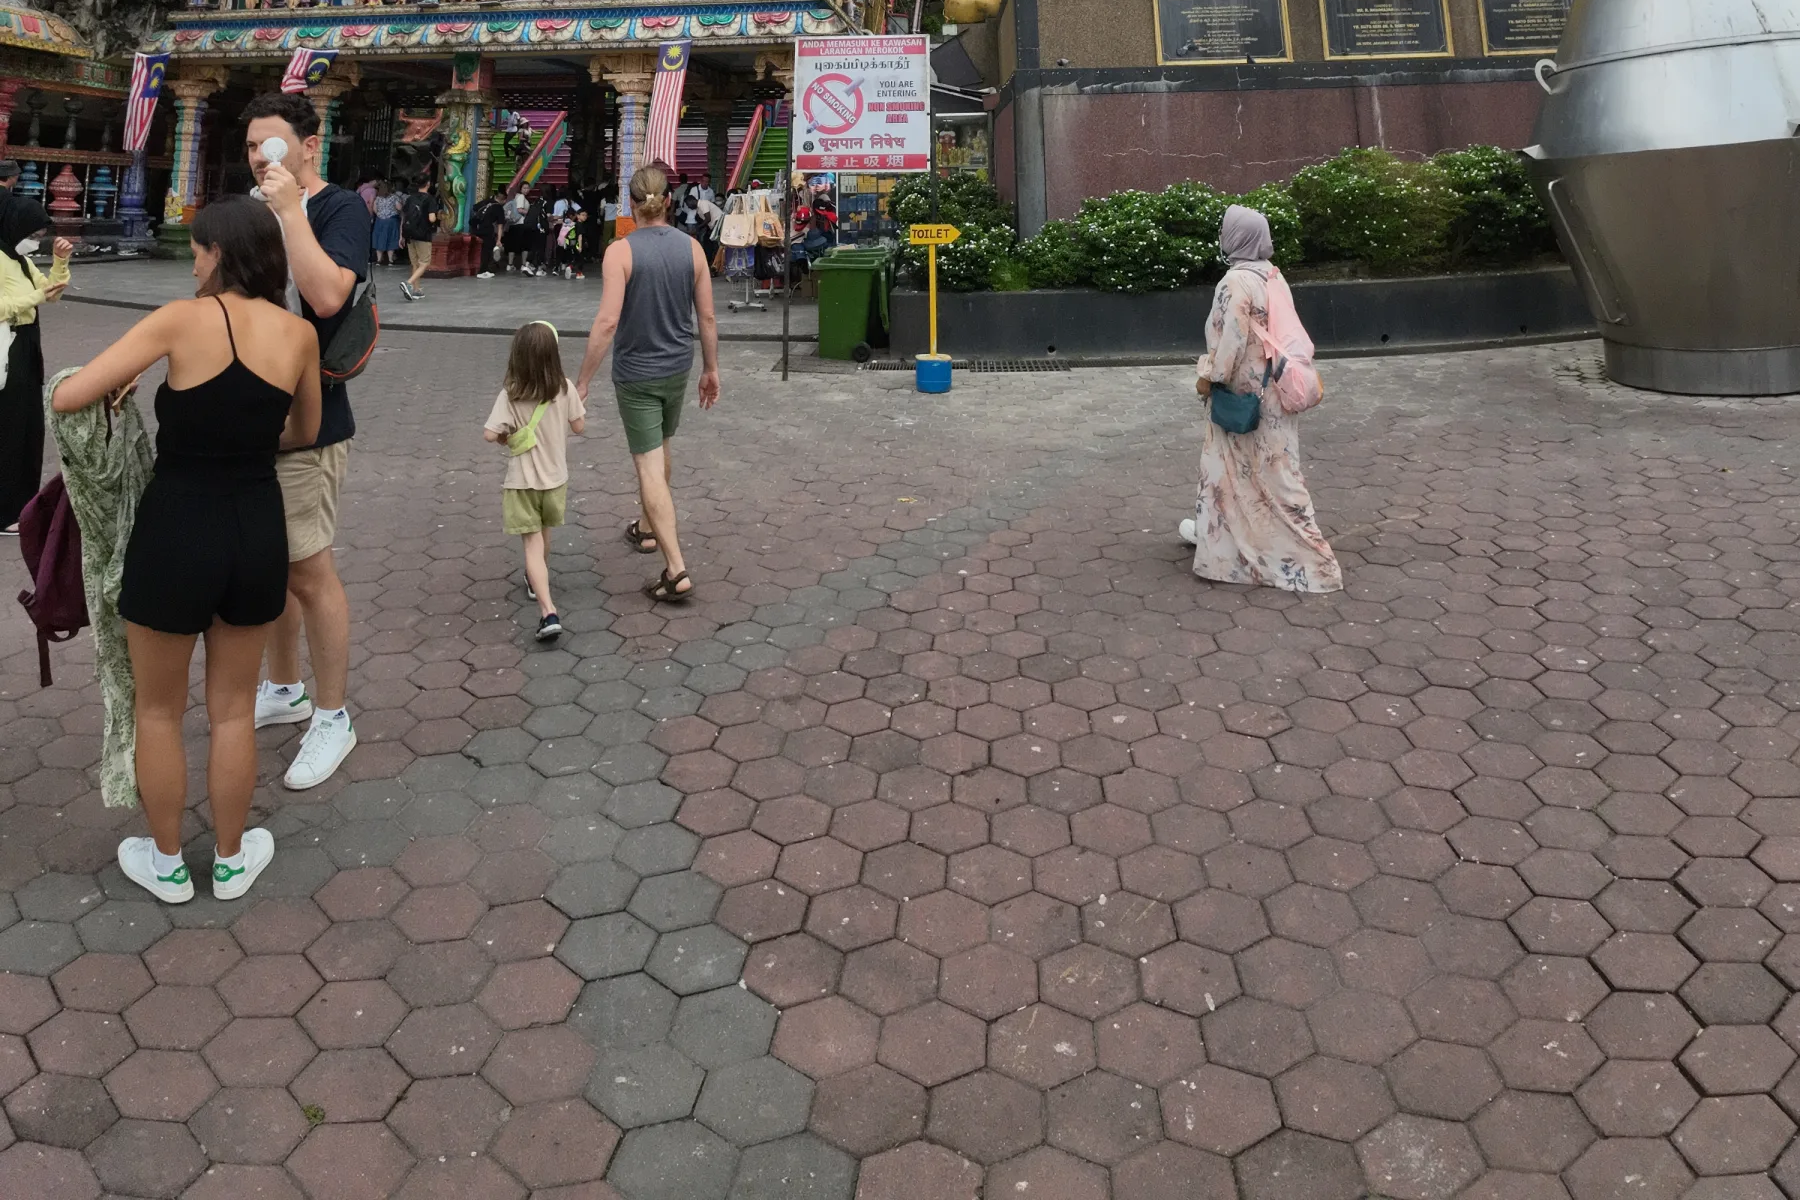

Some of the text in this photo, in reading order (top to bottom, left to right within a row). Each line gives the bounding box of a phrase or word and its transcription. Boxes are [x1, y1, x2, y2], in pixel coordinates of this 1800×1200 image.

[812, 82, 856, 124] NO SMOKING
[868, 102, 925, 112] NON SMOKING
[886, 114, 908, 123] AREA
[912, 229, 950, 238] TOILET
